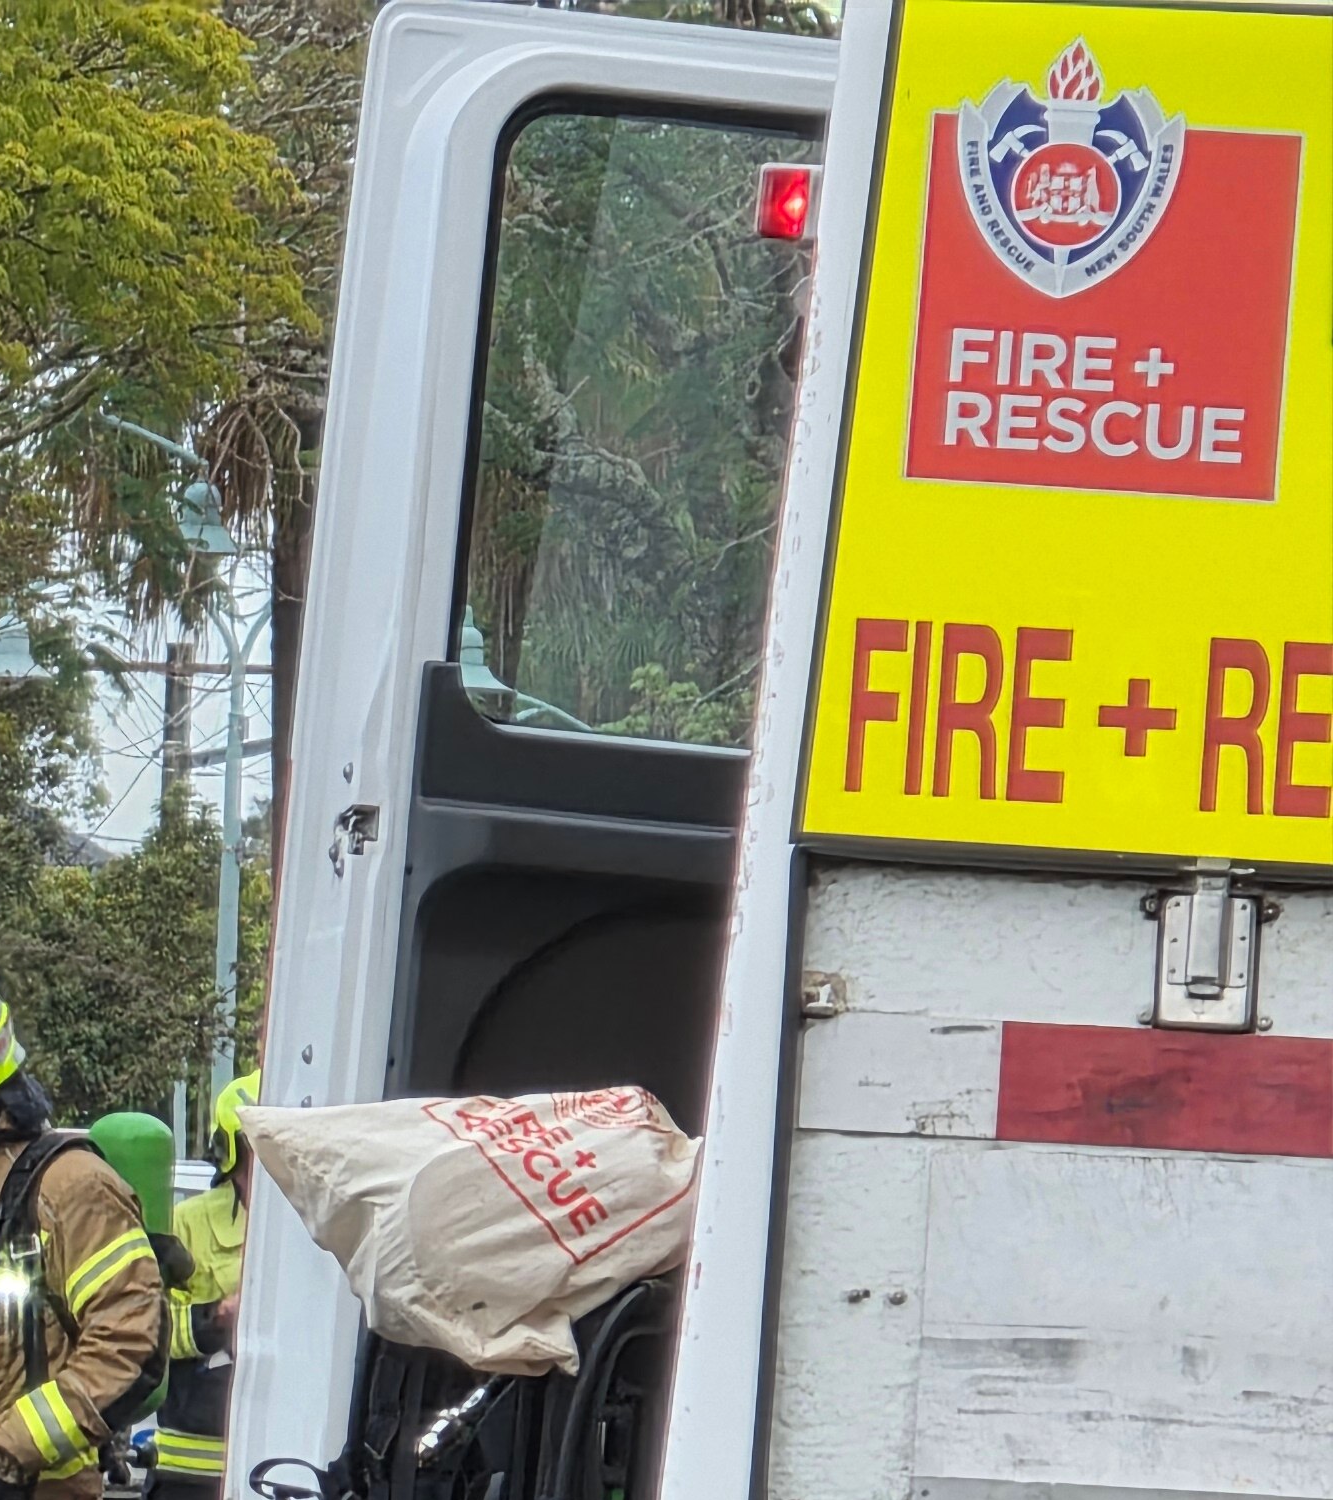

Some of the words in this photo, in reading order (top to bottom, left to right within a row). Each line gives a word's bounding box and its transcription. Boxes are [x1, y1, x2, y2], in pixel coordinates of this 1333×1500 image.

[948, 328, 1117, 392] FIRE
[943, 390, 1245, 464] RESCUE
[844, 618, 1074, 804] FIRE
